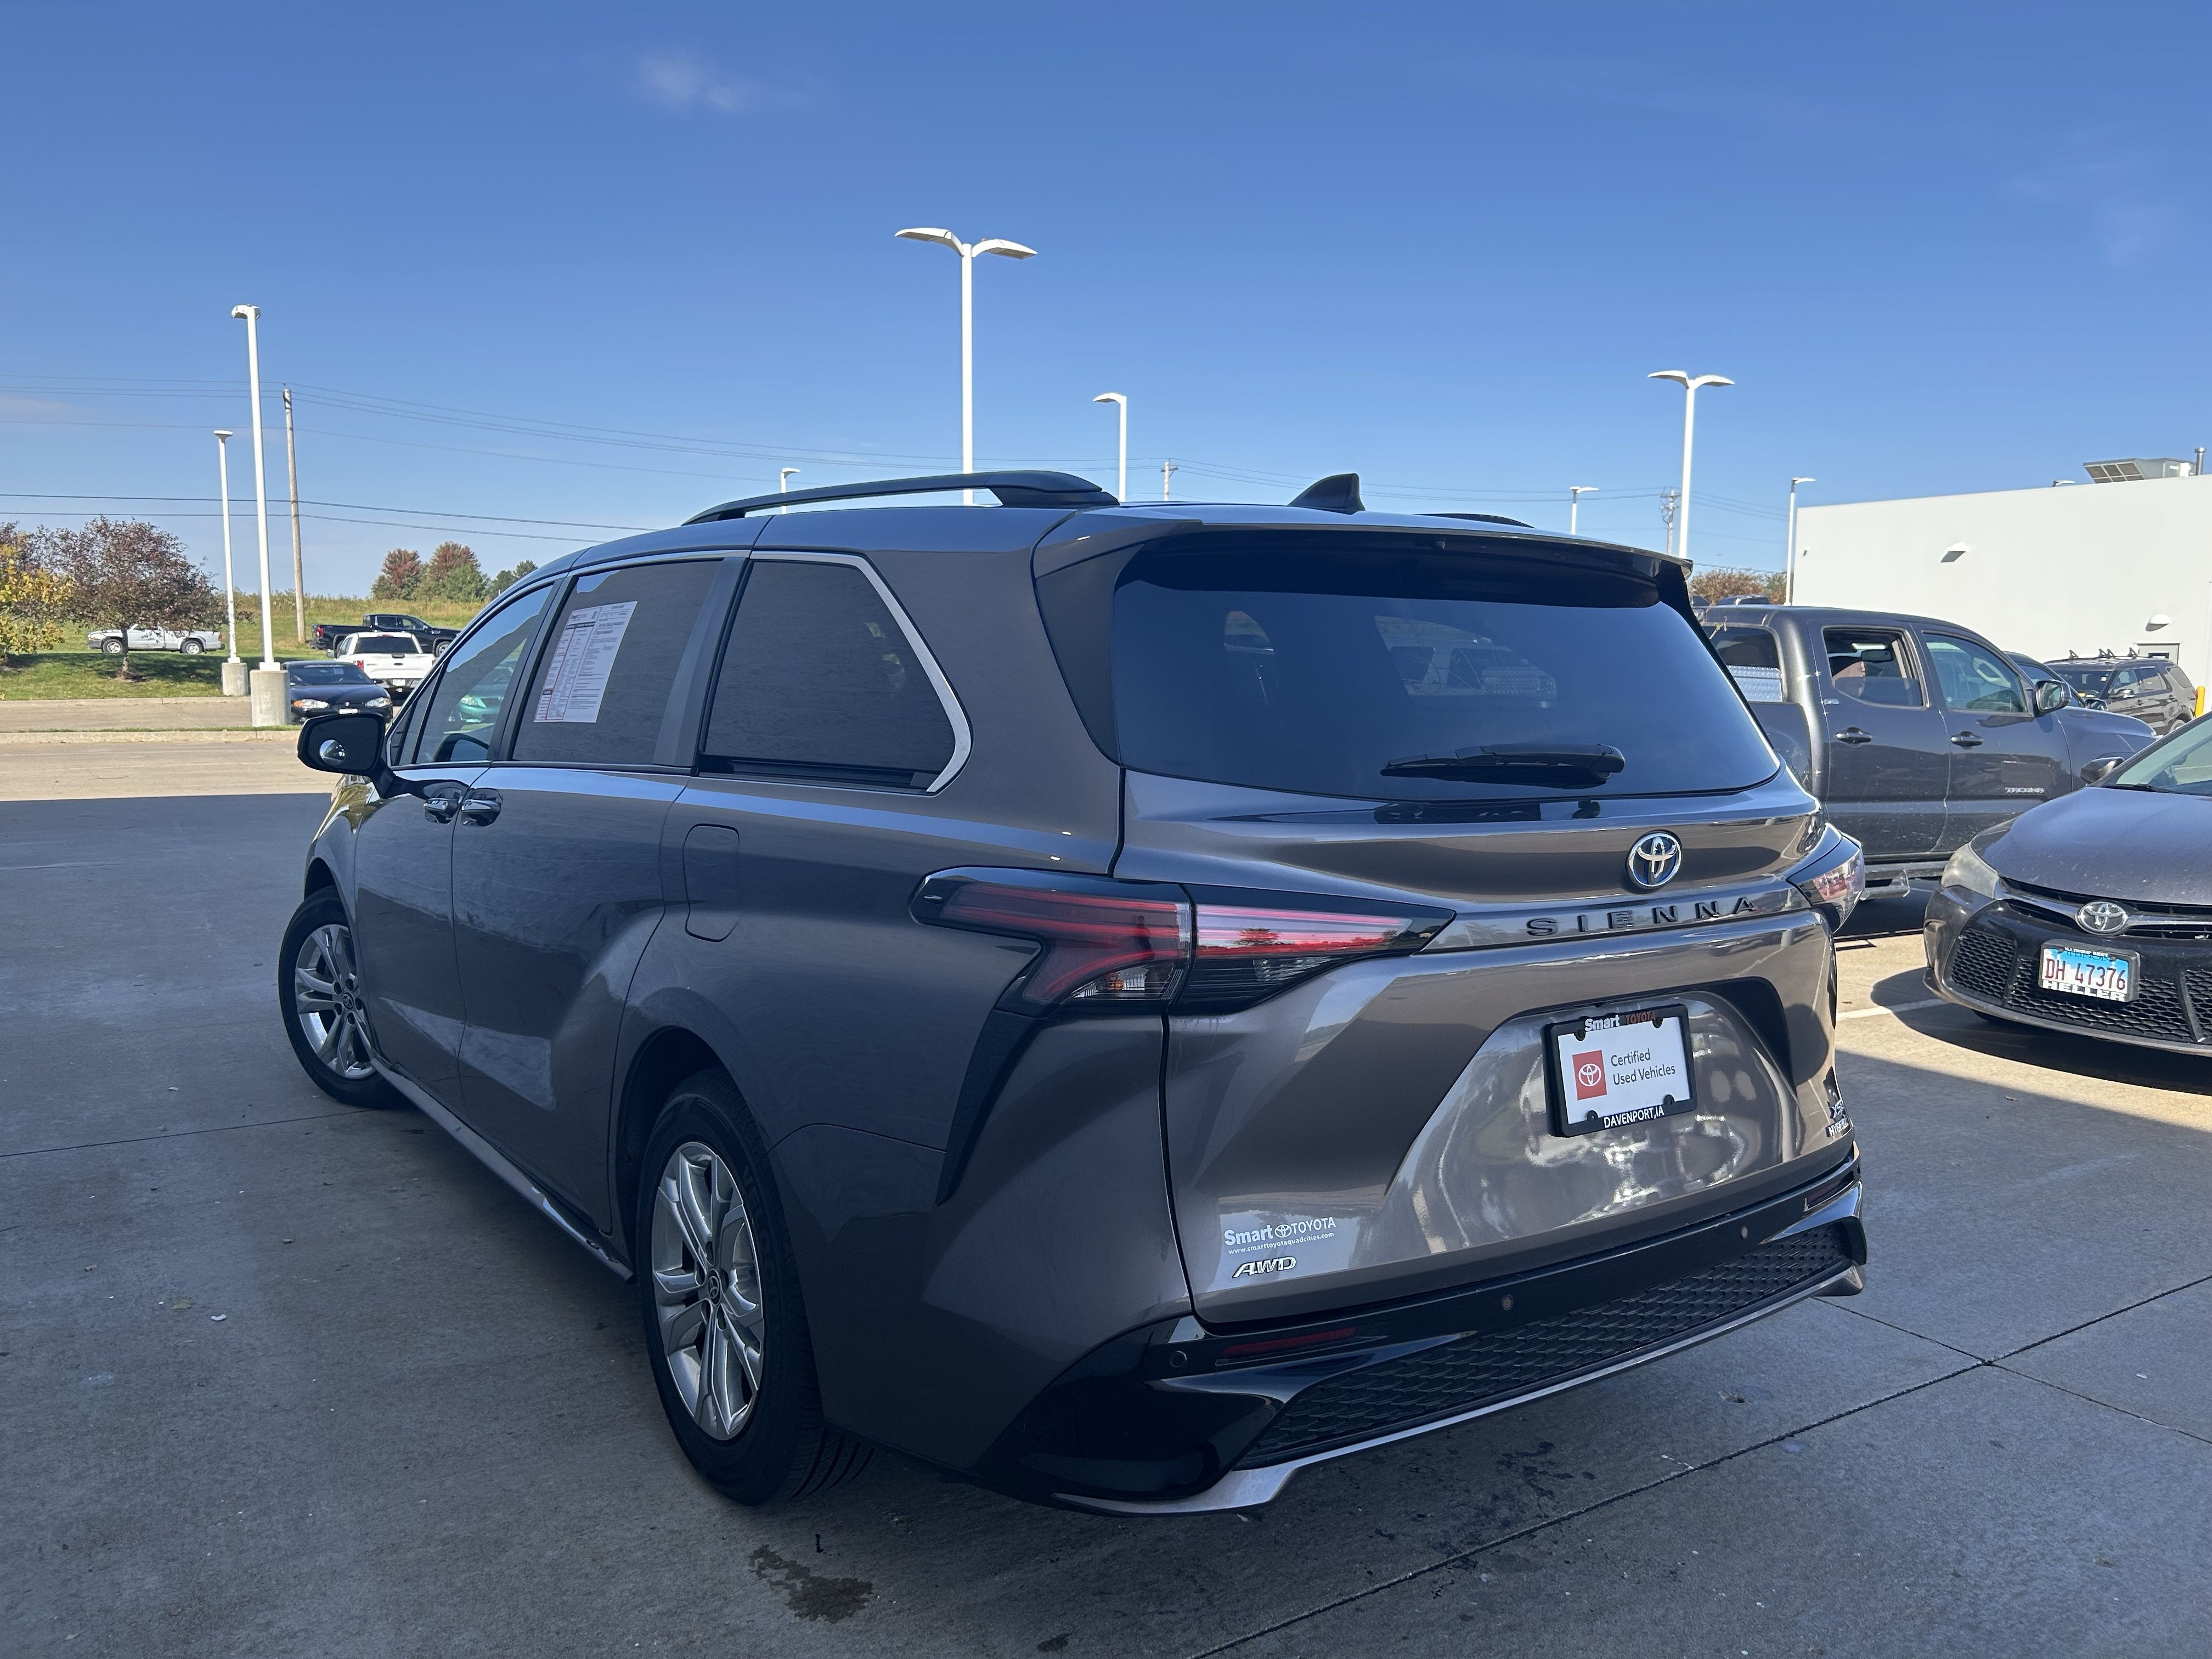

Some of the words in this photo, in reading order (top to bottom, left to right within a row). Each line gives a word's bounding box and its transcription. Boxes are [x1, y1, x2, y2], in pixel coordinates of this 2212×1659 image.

[1526, 897, 1757, 936] SIENNA
[2074, 963, 2125, 990] 47376
[2042, 980, 2125, 1002] HELLER
[1584, 1015, 1620, 1032] Smart
[1624, 1011, 1656, 1025] TOYOTA
[1610, 1048, 1651, 1067] Certified
[1613, 1070, 1637, 1086] Used
[1638, 1064, 1676, 1080] Vehicles
[1603, 1106, 1664, 1128] DAVENPORT,IA
[1224, 1224, 1274, 1246] Smart
[1290, 1216, 1336, 1234] TOYOTA
[1228, 1231, 1335, 1255] www.smarttoyotaquadcities.com
[1232, 1256, 1296, 1278] AWD
